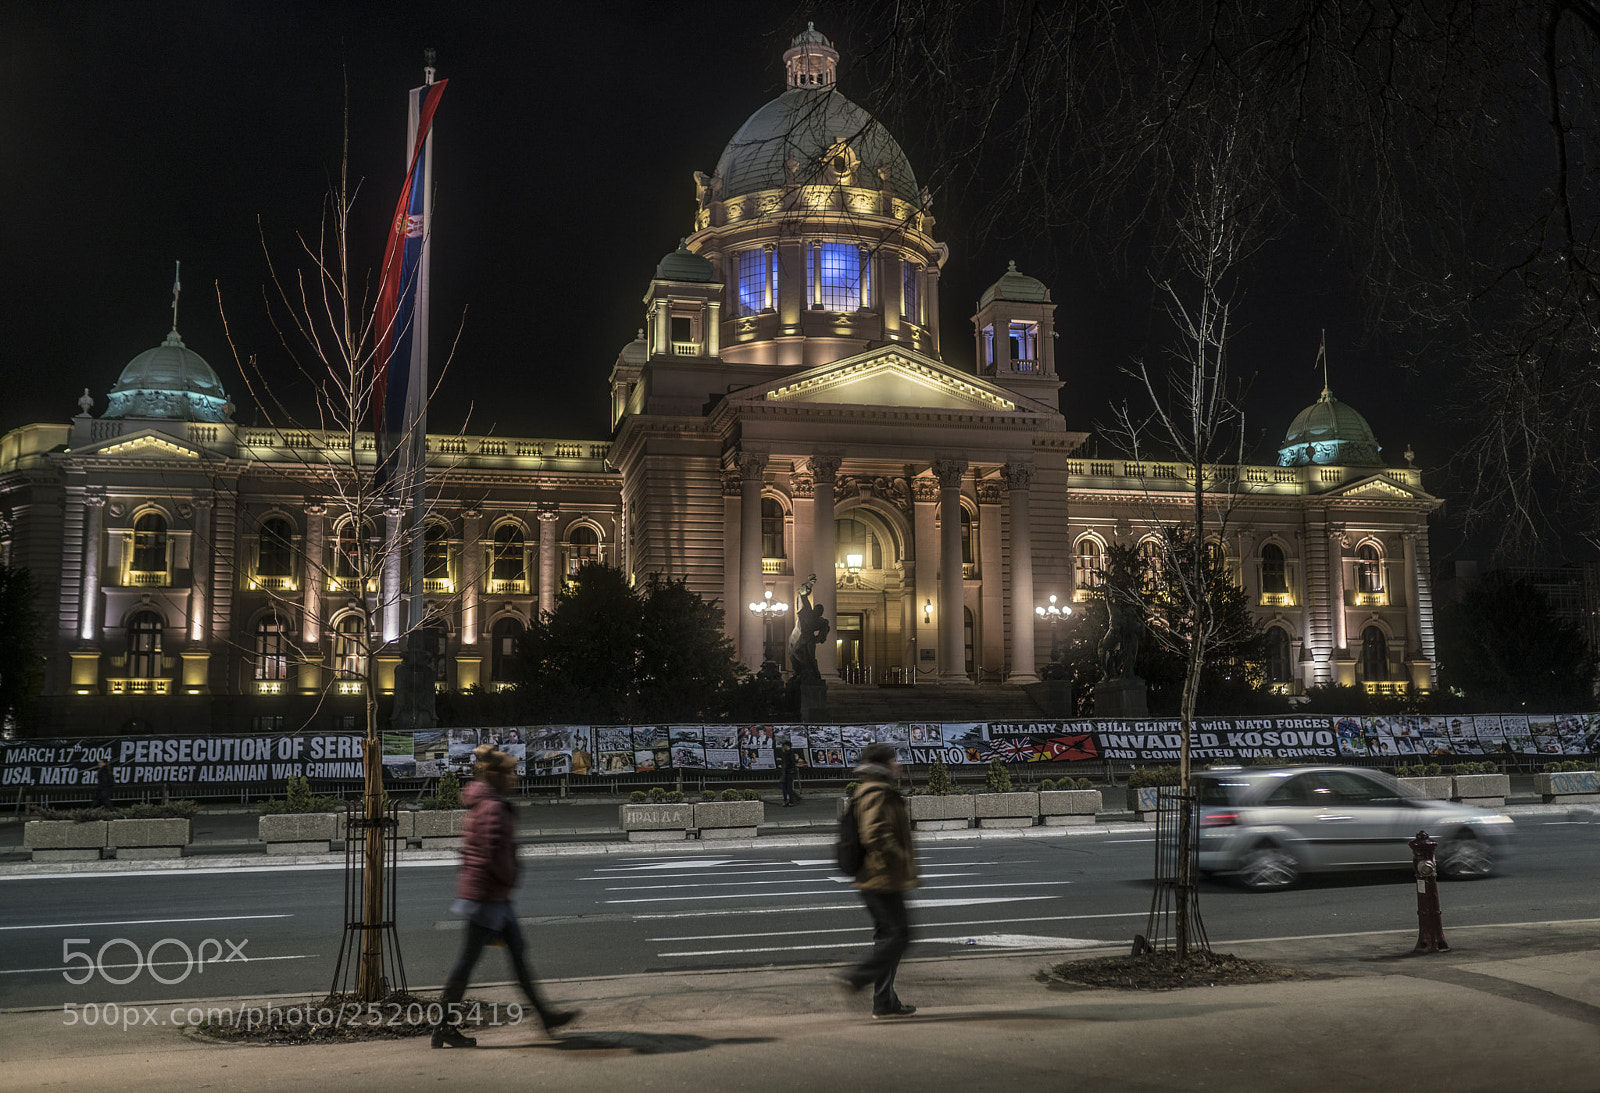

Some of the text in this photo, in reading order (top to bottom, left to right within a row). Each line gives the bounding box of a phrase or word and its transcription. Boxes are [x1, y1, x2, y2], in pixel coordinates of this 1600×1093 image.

[992, 723, 1056, 734] HILLARY
[1062, 723, 1092, 733] AND
[1099, 721, 1130, 732] BILL
[1201, 720, 1231, 731] with
[1235, 719, 1272, 730] NATO
[1276, 718, 1330, 729] FORCES
[1098, 731, 1333, 749] INVADED KOSOVO
[5, 747, 55, 764] MARCH
[81, 747, 112, 763] 2004
[120, 738, 272, 763] PERSECUTION
[278, 737, 305, 761] OF
[912, 747, 964, 764] NATO
[1104, 749, 1137, 759] AND
[1238, 747, 1274, 758] WAR
[1277, 747, 1337, 757] CRIMES
[2, 767, 35, 786] USA,
[39, 767, 79, 785] NATO
[82, 770, 99, 785] an
[113, 766, 131, 784] EU
[134, 765, 196, 783] PROTECT
[198, 763, 268, 782] ALBANIAN
[271, 763, 303, 780] WAR
